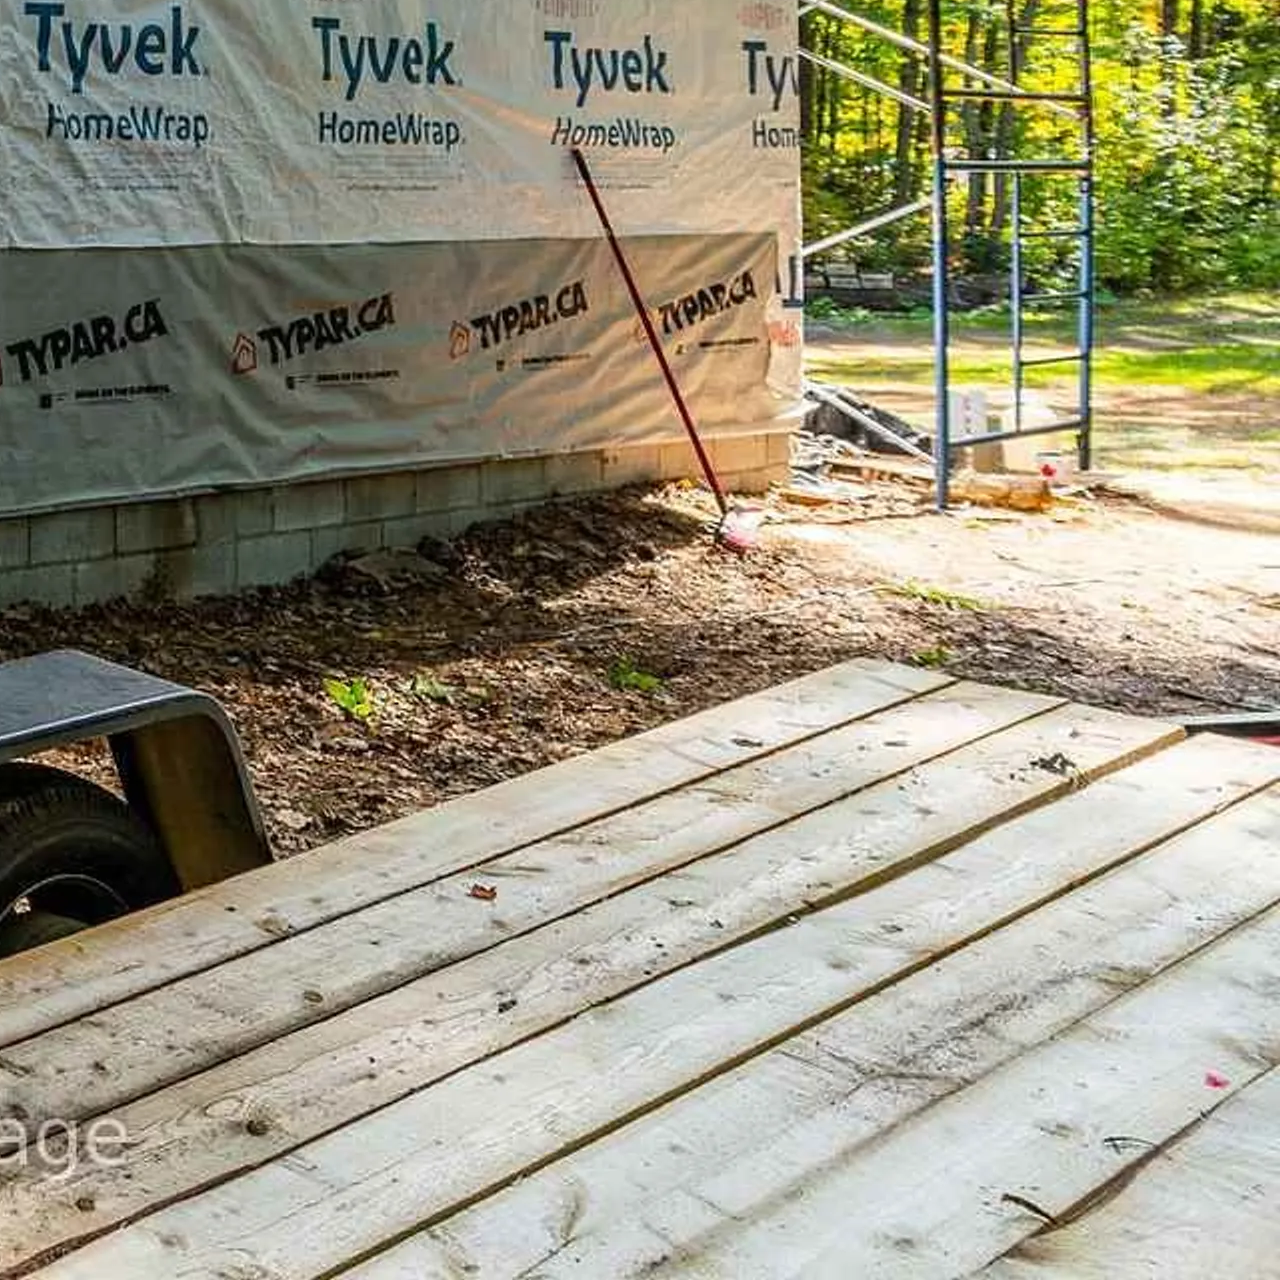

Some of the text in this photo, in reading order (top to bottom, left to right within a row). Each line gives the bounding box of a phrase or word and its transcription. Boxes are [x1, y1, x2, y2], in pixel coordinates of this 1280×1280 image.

[24, 1, 203, 94] Tyvek
[312, 16, 456, 101] Tyvek
[543, 31, 670, 108] Tyvek
[46, 103, 210, 148] HomeWrap
[318, 112, 461, 149] HomeWrap
[551, 116, 676, 151] HomeWrap
[6, 299, 170, 382] TYPAR.CA
[257, 293, 397, 365] TYPAR.CA
[471, 280, 589, 349] TYPAR.CA
